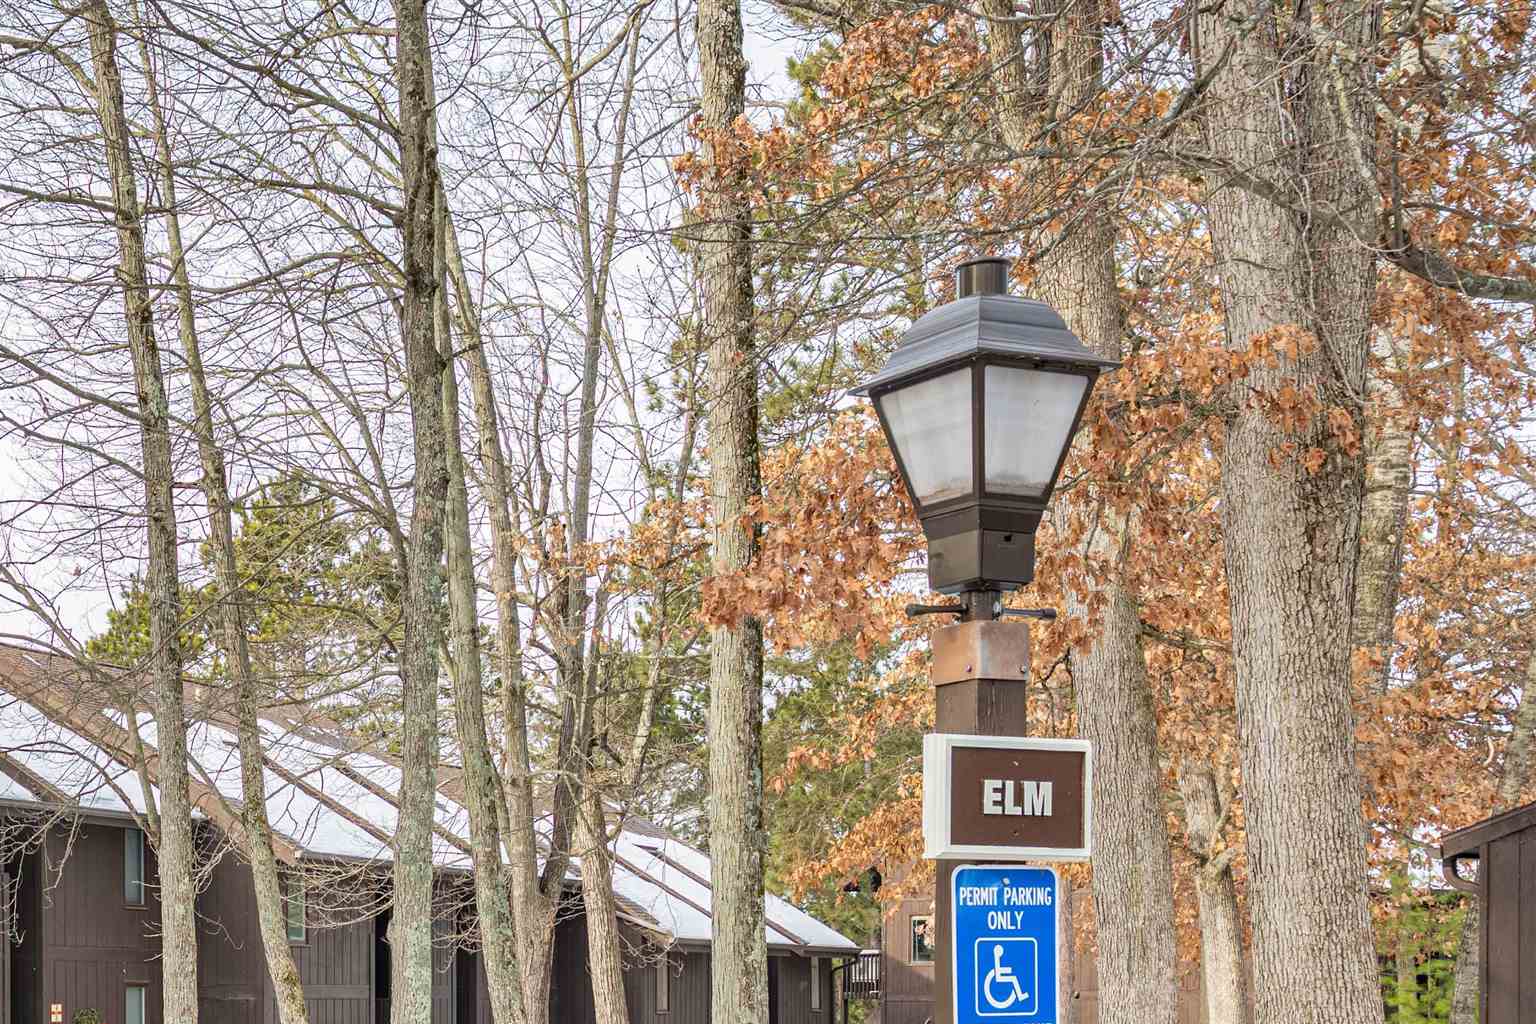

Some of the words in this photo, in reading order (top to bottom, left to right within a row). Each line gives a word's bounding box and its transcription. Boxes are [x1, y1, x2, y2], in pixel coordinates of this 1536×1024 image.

[983, 779, 1053, 817] ELM
[959, 886, 998, 907] PERMIT
[1003, 886, 1052, 906] PARKING
[987, 910, 1024, 931] ONLY
